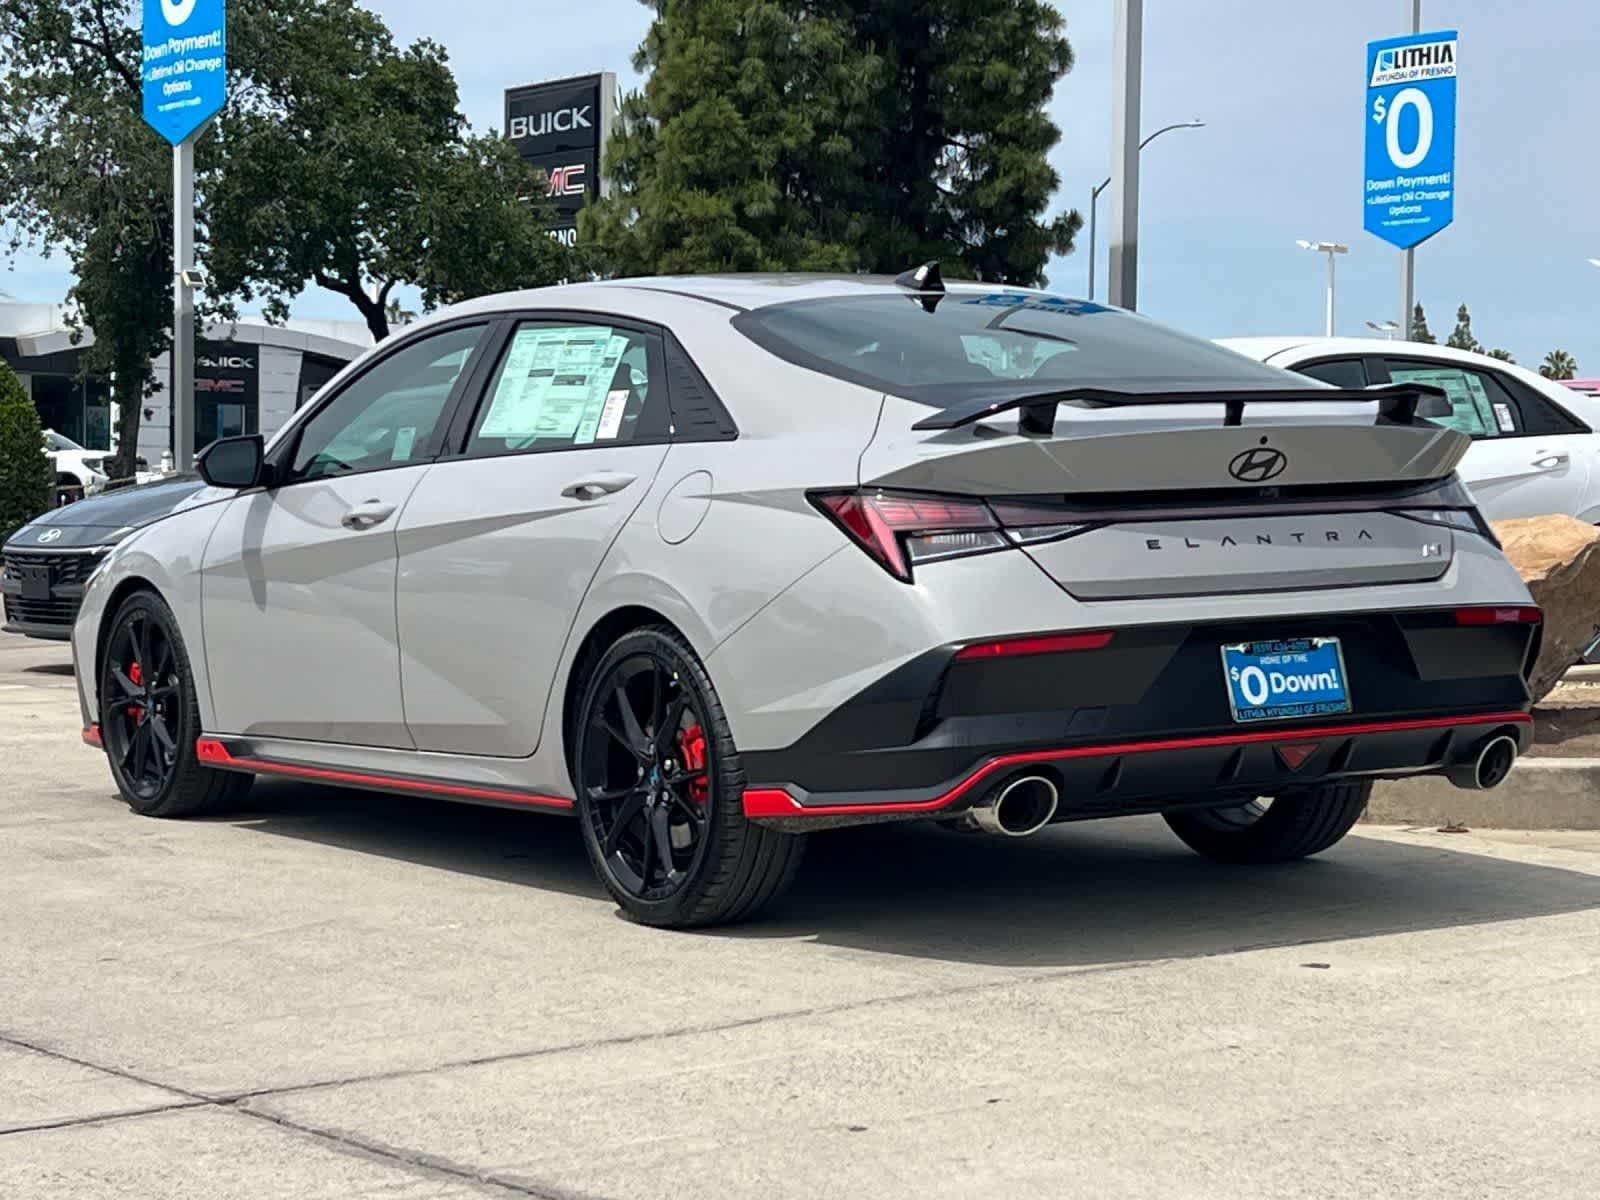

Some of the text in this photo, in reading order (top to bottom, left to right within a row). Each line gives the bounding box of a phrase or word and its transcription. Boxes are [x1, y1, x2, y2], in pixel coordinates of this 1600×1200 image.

[144, 30, 221, 61] Down Payment!
[185, 58, 221, 72] Change
[1394, 43, 1454, 69] LITHIA
[1420, 65, 1454, 77] FRESNO
[509, 105, 593, 139] BUICK
[1366, 172, 1450, 192] Down Payment!
[1146, 530, 1373, 550] ELANTRA
[1294, 654, 1308, 662] THE
[1269, 668, 1339, 693] Down!
